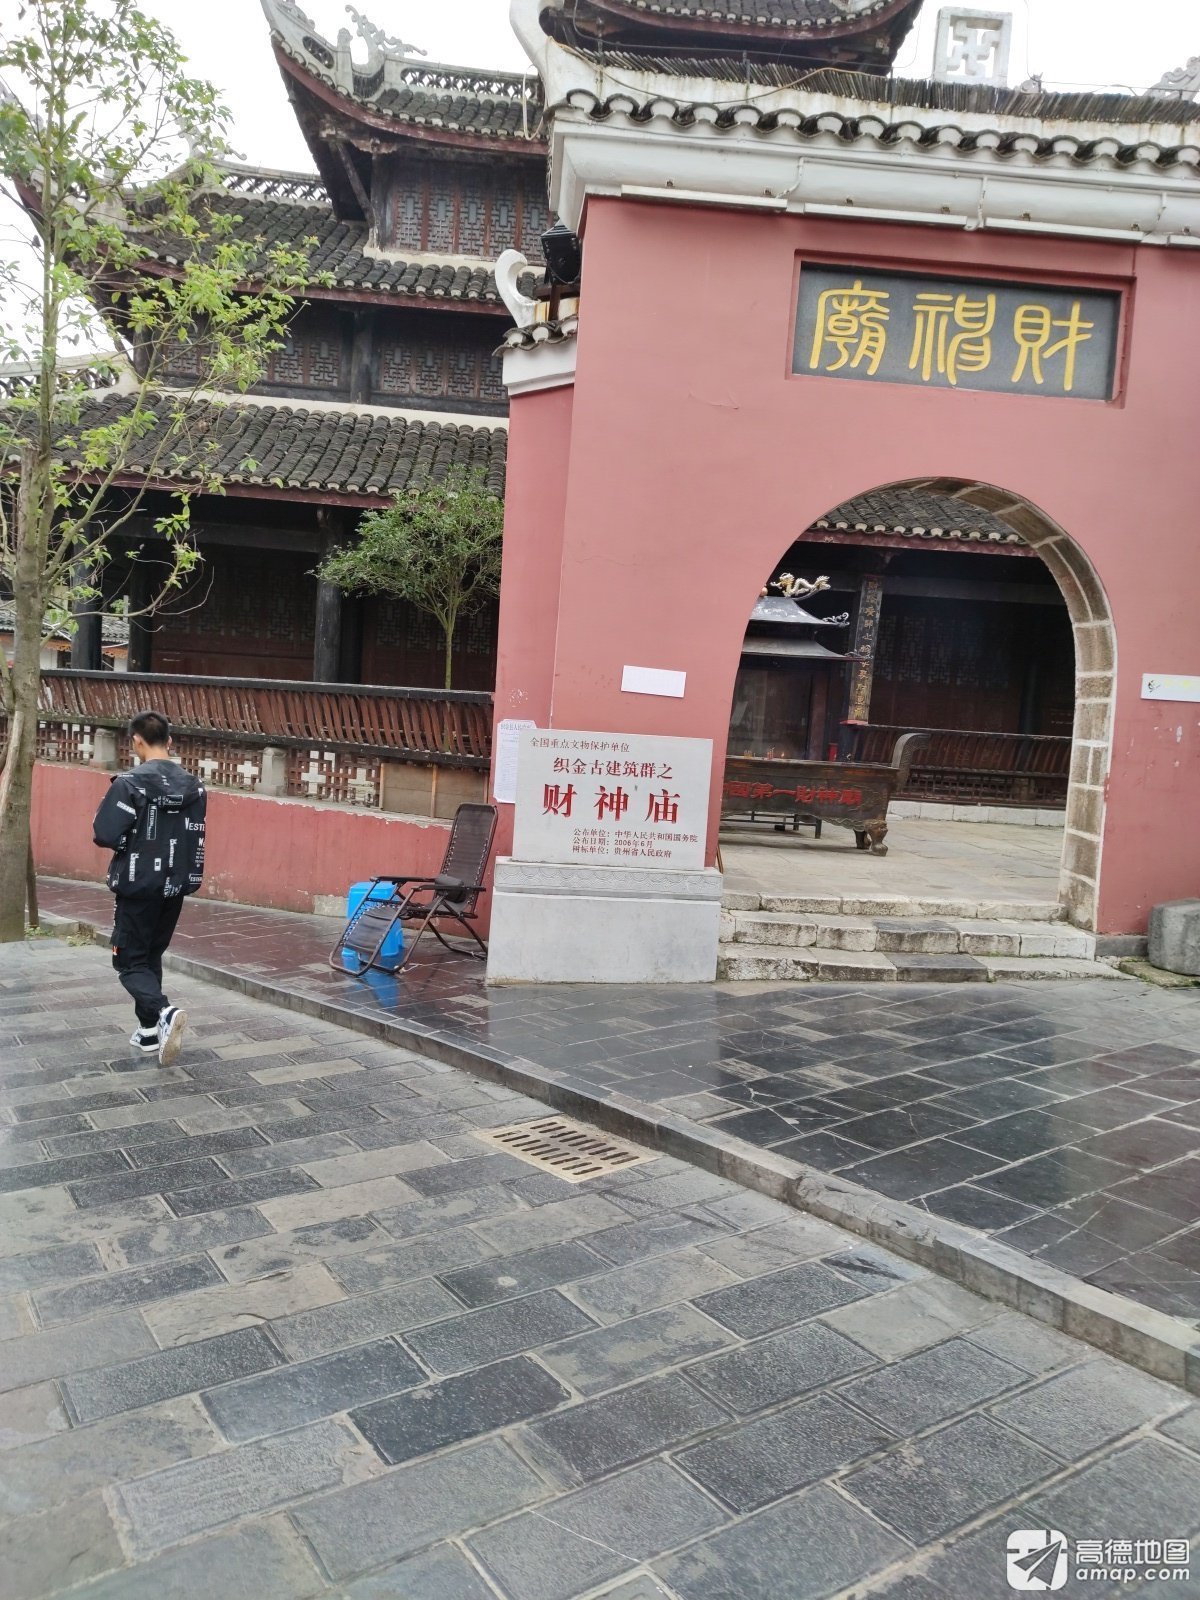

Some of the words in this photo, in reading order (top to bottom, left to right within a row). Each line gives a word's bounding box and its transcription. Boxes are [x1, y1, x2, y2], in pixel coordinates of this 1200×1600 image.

[530, 737, 630, 753] 全国重点文物保护单位
[553, 757, 673, 779] 织金古建筑群之
[542, 783, 681, 824] 财神庙
